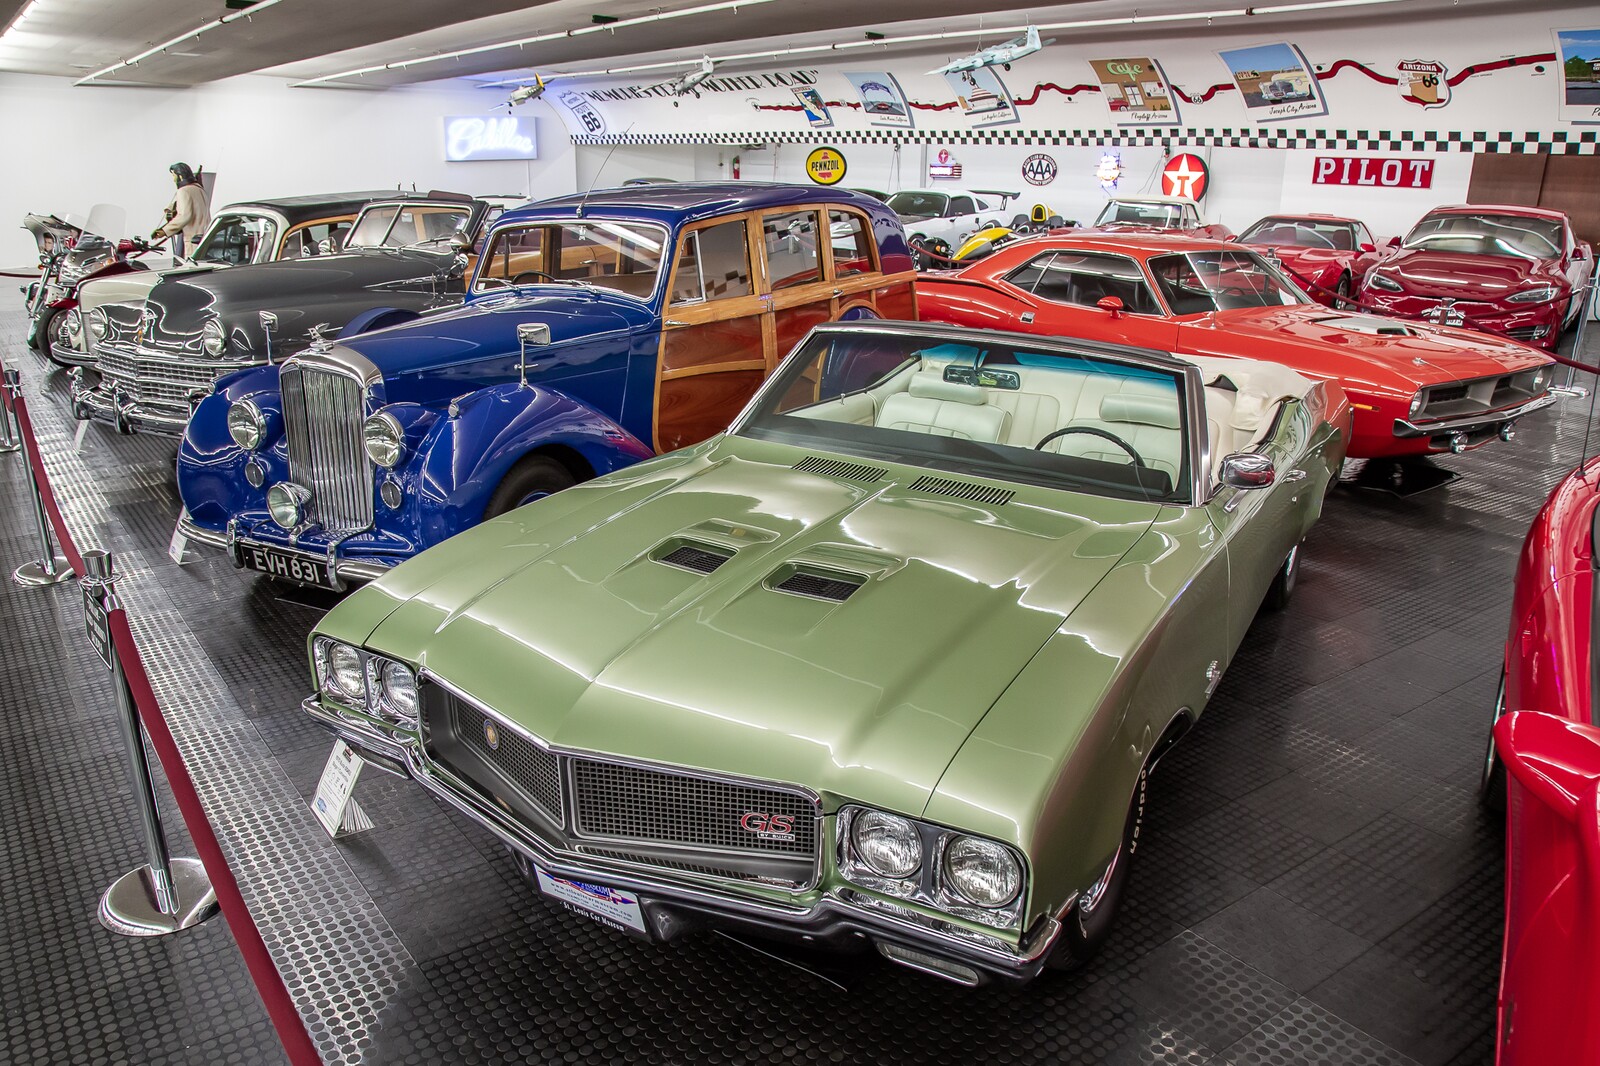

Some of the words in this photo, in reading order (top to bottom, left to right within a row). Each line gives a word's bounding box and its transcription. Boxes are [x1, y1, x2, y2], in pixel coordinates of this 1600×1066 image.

[1106, 62, 1144, 81] Cafe
[1402, 63, 1438, 71] ARIZONA
[1422, 73, 1440, 88] 66
[581, 111, 602, 133] 66
[811, 159, 840, 171] PENNZOIL
[1027, 160, 1052, 180] AAA
[1317, 158, 1430, 187] PILOT
[252, 550, 289, 576] EVH
[291, 559, 320, 583] 831
[740, 812, 795, 834] GS
[573, 905, 589, 918] Louis
[589, 912, 601, 922] Car
[600, 916, 625, 931] Museum
